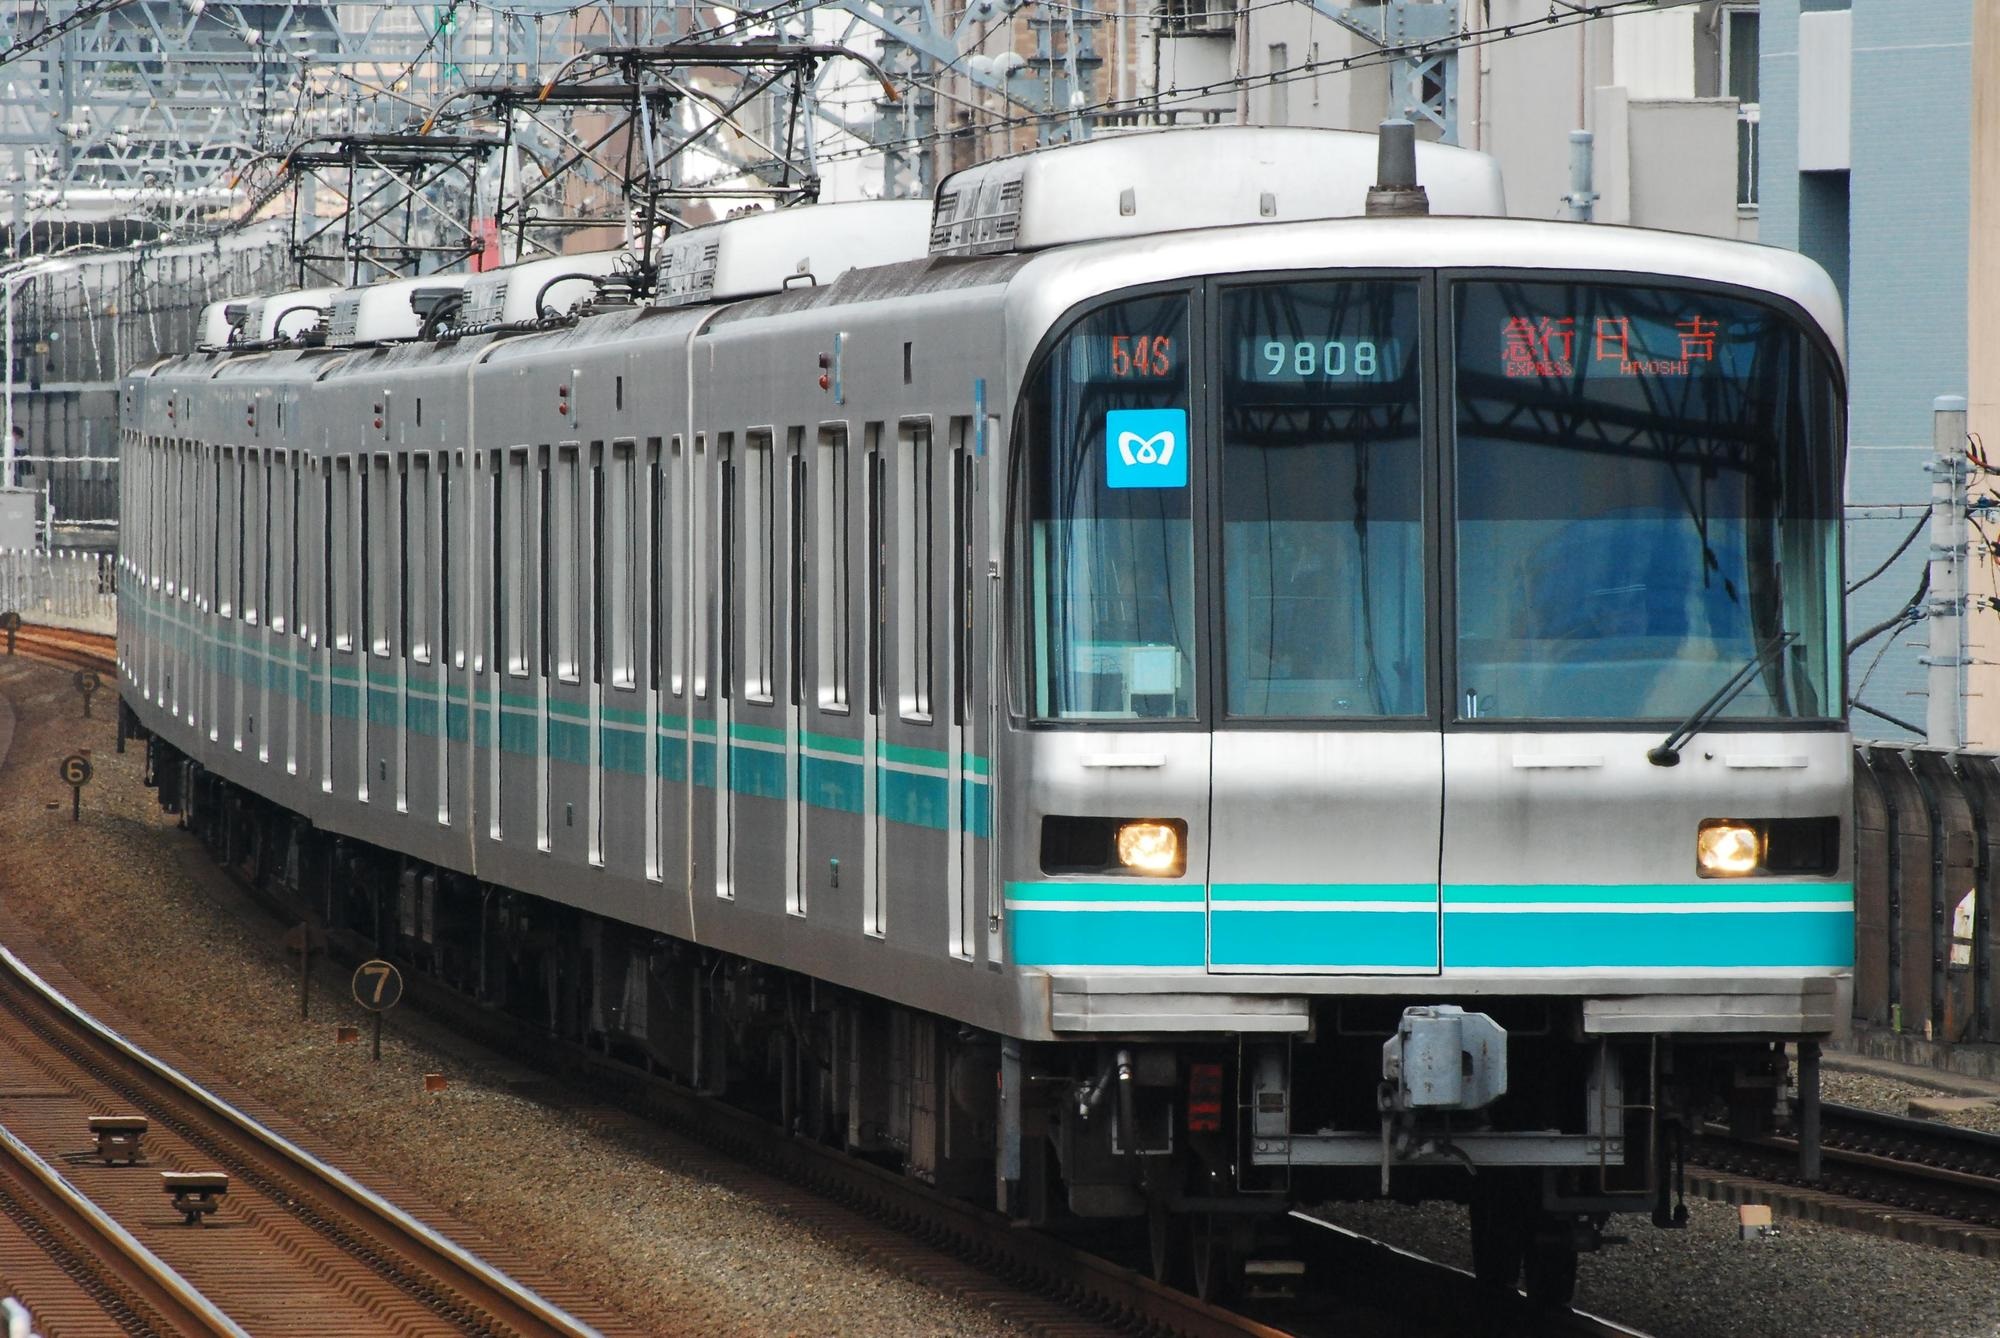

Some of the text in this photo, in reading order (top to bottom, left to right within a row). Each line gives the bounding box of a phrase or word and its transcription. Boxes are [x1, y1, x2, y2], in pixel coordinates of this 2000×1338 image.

[1112, 335, 1169, 376] 54S
[1501, 315, 1720, 361] 急行 日吉
[1263, 342, 1376, 376] 9808
[1505, 360, 1690, 377] EXPRESS HIYOSHI
[66, 759, 85, 782] 6
[363, 966, 391, 1003] 7
